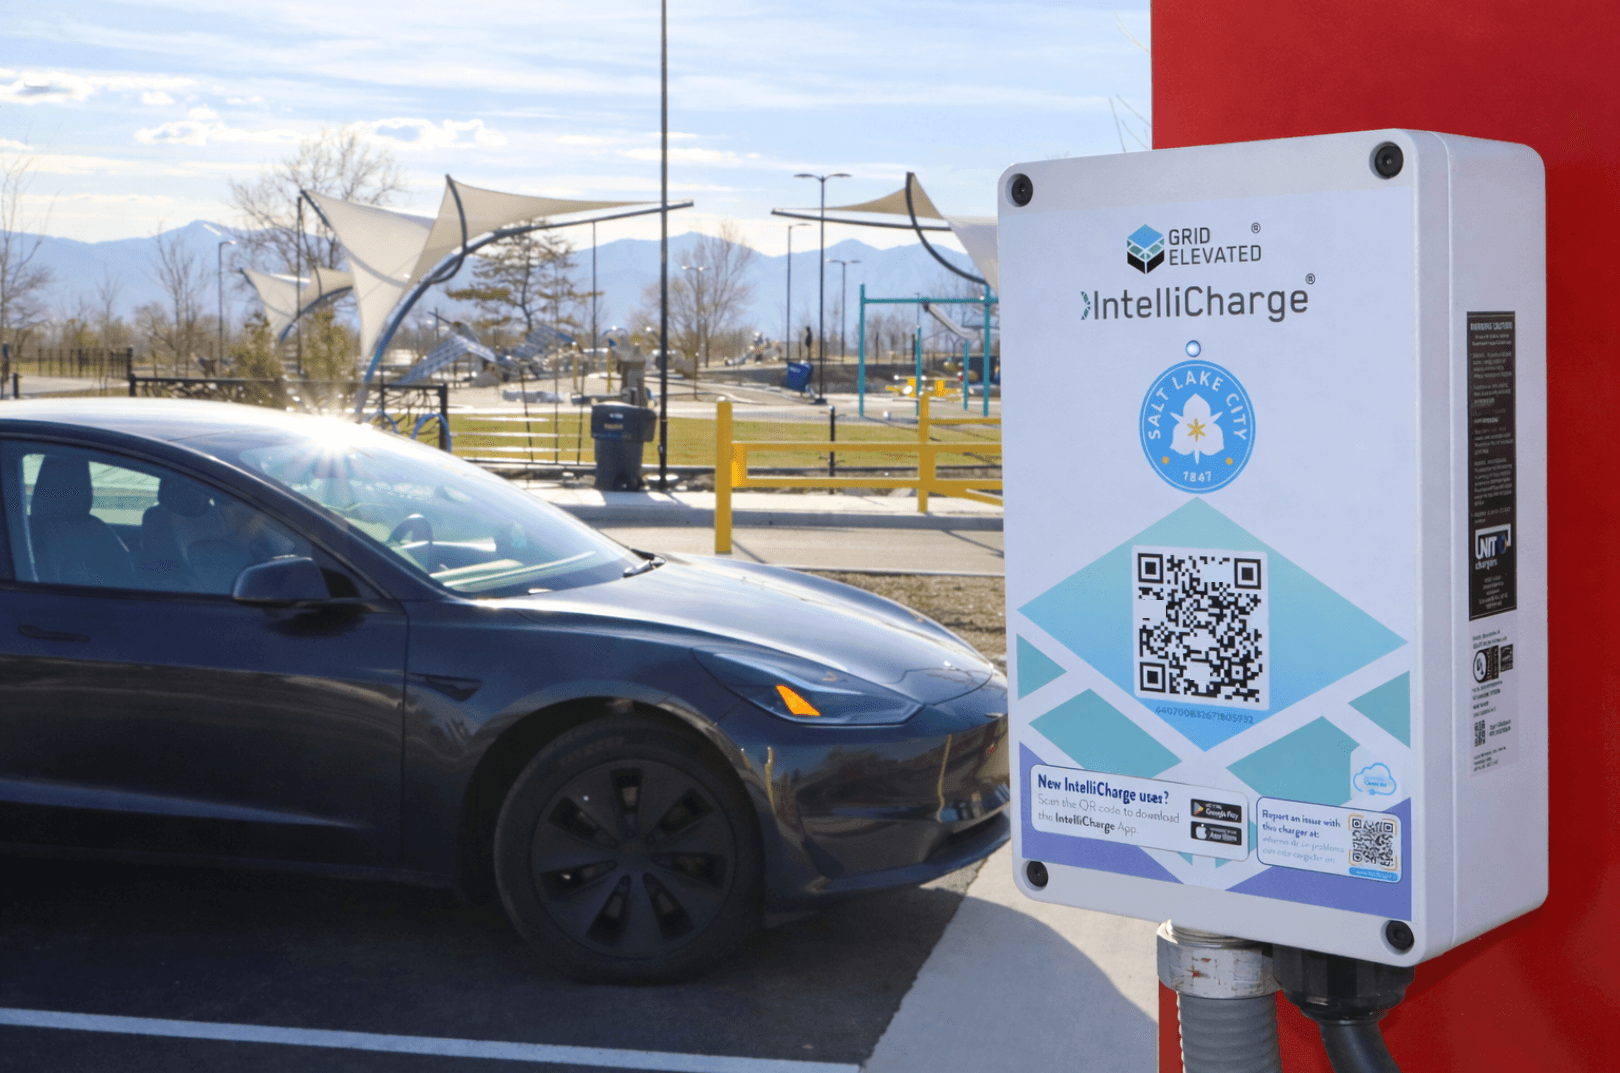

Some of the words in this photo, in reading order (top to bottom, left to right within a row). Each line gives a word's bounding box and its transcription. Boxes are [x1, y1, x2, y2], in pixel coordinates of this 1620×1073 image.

[1169, 227, 1211, 246] GRID
[1169, 245, 1262, 266] ELEVATED
[1094, 286, 1309, 323] IntelliCharge
[1147, 387, 1169, 440] SALT
[1172, 370, 1224, 392] LAKE
[1226, 393, 1248, 441] CITY
[1183, 470, 1212, 482] 1847
[1038, 773, 1061, 790] New
[1065, 777, 1136, 804] IntelliCharge
[1037, 793, 1060, 806] Scan
[1062, 796, 1077, 809] the
[1079, 799, 1096, 812] QR
[1123, 807, 1134, 817] to
[1135, 808, 1180, 824] download
[1262, 809, 1289, 822] Report
[1291, 815, 1301, 823] an
[1301, 814, 1322, 825] issue
[1323, 818, 1341, 828] with
[1038, 810, 1053, 822] the
[1055, 812, 1115, 834] IntelliCharge
[1278, 825, 1308, 839] charger
